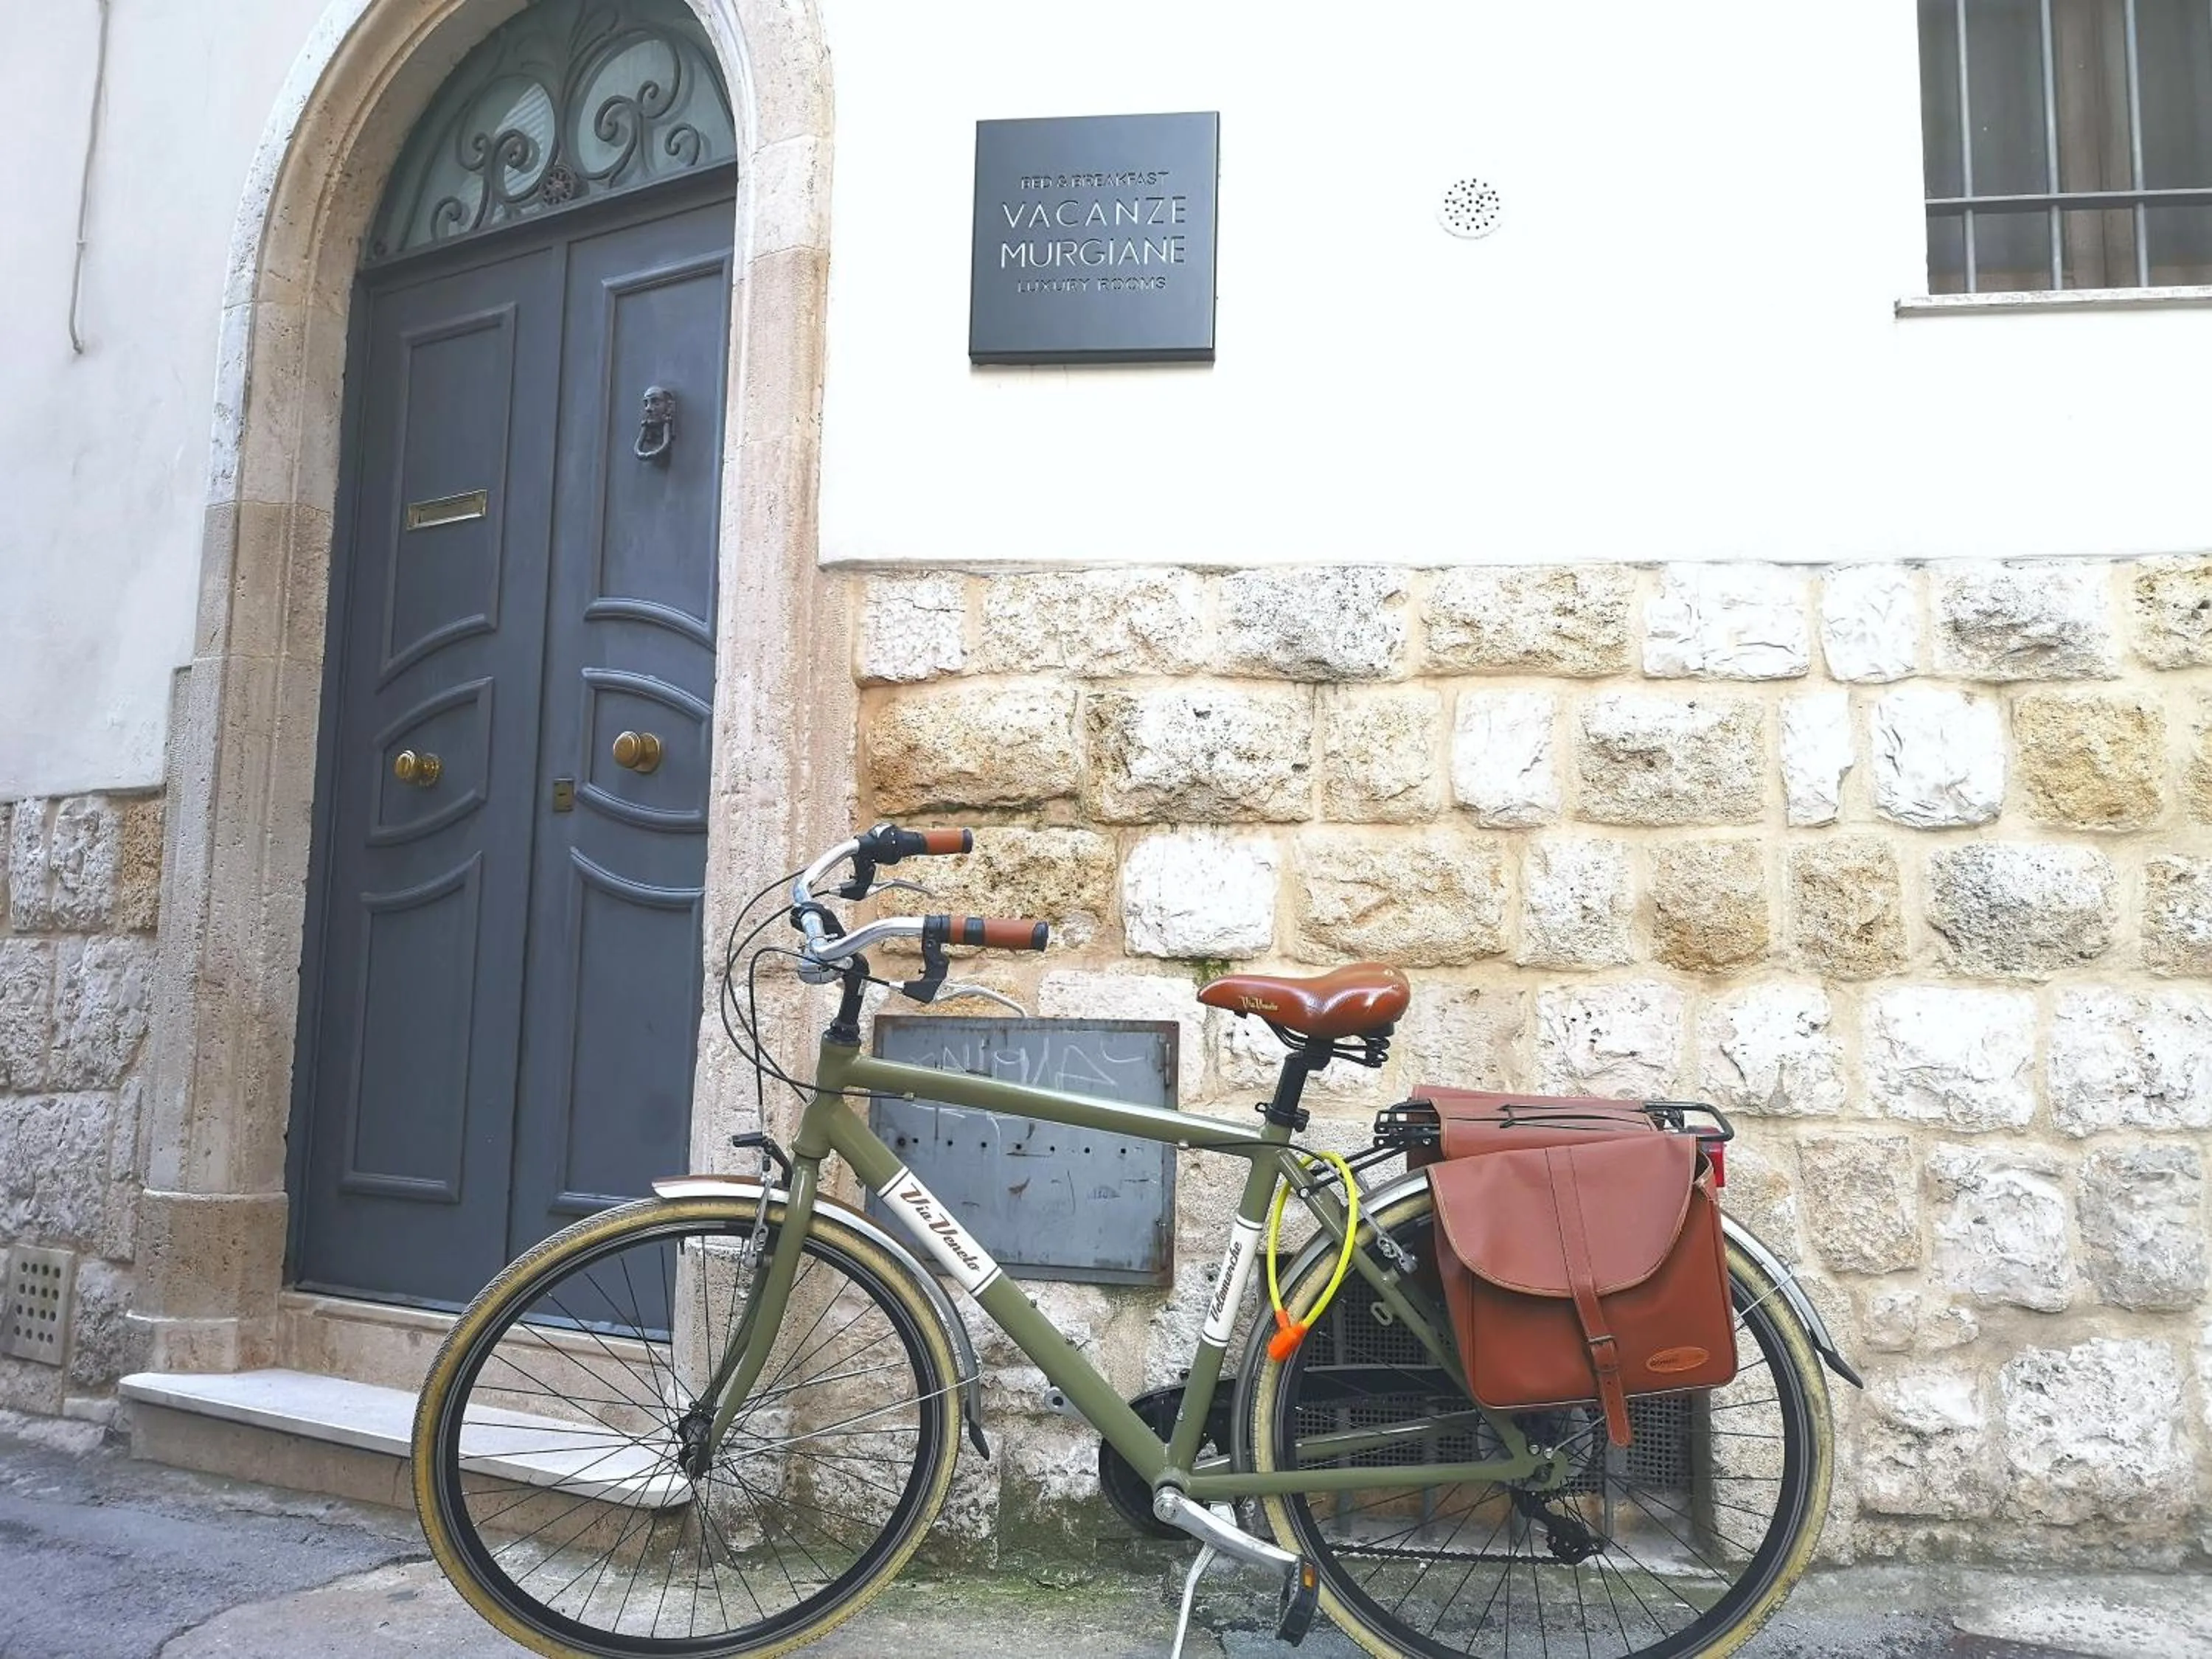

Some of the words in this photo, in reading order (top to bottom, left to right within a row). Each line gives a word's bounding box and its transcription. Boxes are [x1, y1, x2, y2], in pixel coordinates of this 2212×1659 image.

[1021, 175, 1052, 189] BED
[1057, 174, 1068, 188] &
[1071, 171, 1169, 188] BREAKFAST
[1002, 196, 1186, 228] VACANZE
[1001, 235, 1186, 269] MURGIANE
[1018, 278, 1091, 294] LUXURY
[1097, 276, 1166, 292] ROOMS
[900, 1182, 933, 1222] Via
[928, 1212, 981, 1272] Veneto
